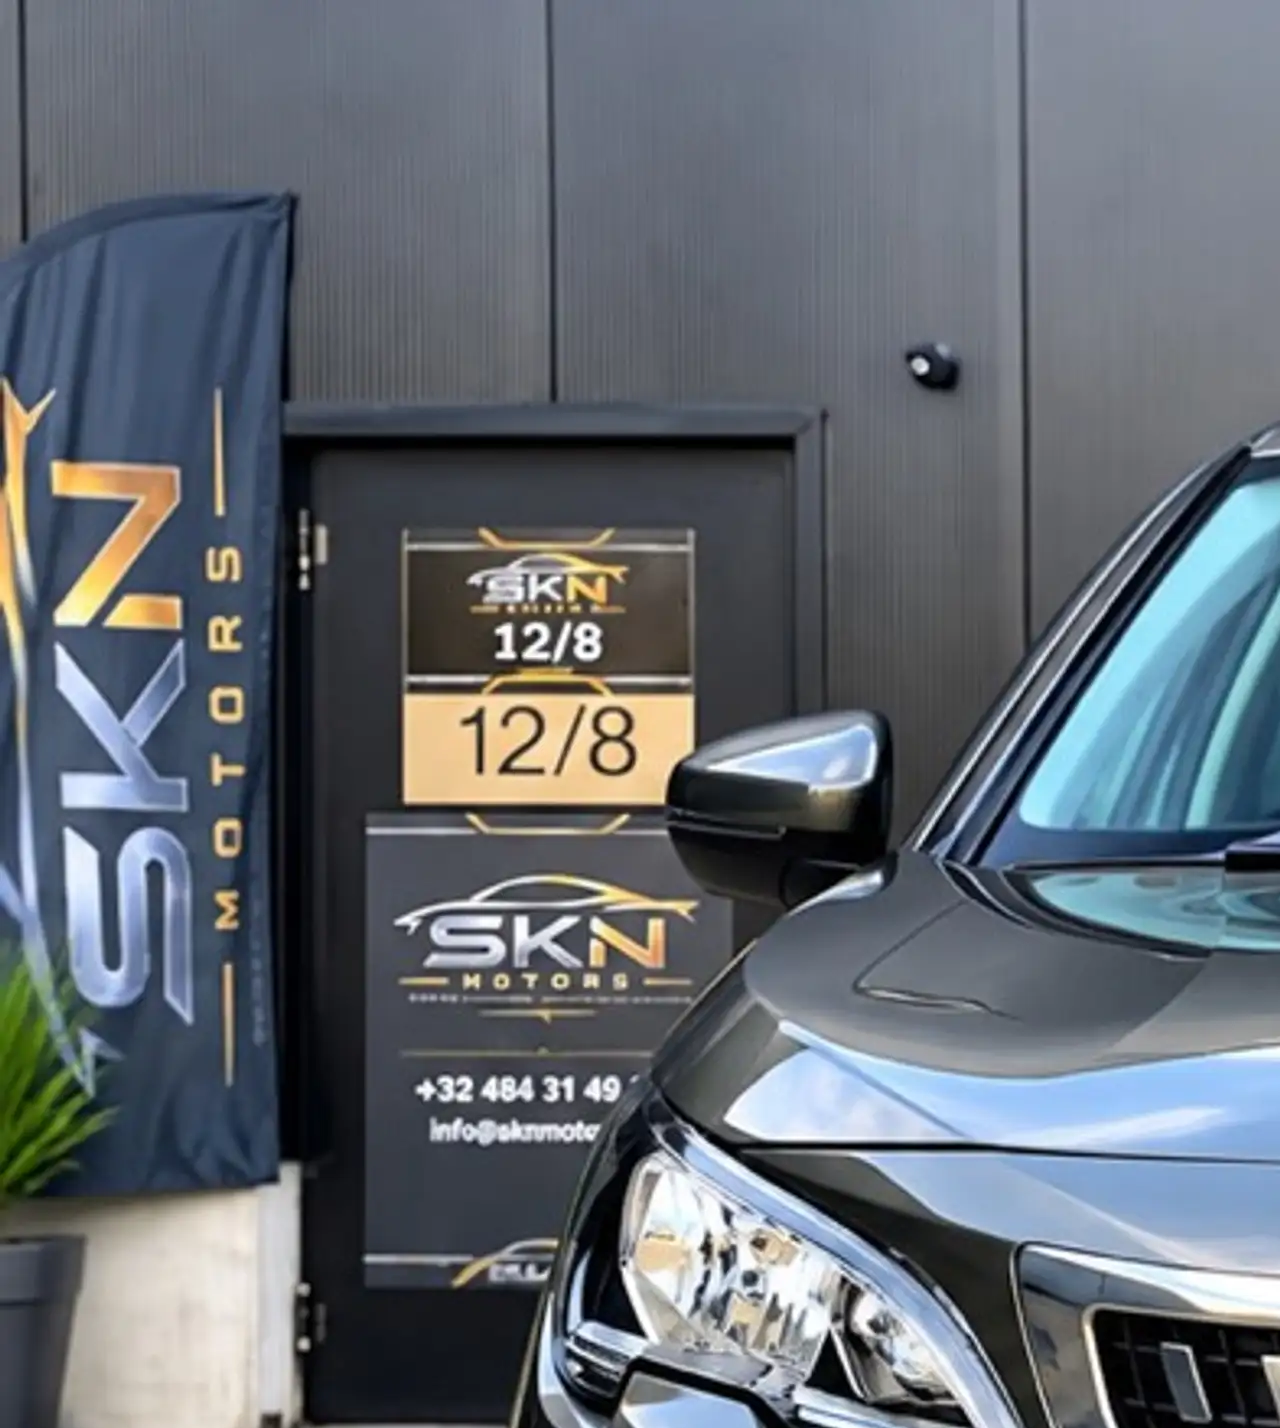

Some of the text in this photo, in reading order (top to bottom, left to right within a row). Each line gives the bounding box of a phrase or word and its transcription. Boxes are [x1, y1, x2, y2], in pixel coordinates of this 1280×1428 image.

[483, 573, 607, 604] SKN
[493, 620, 603, 664] 12/8
[52, 459, 194, 1025] SKN
[207, 543, 244, 932] MOTORS
[460, 703, 638, 777] 12/8
[423, 914, 667, 969] SKN
[462, 972, 631, 991] MOTORS
[414, 1075, 622, 1103] +32 484 31 49
